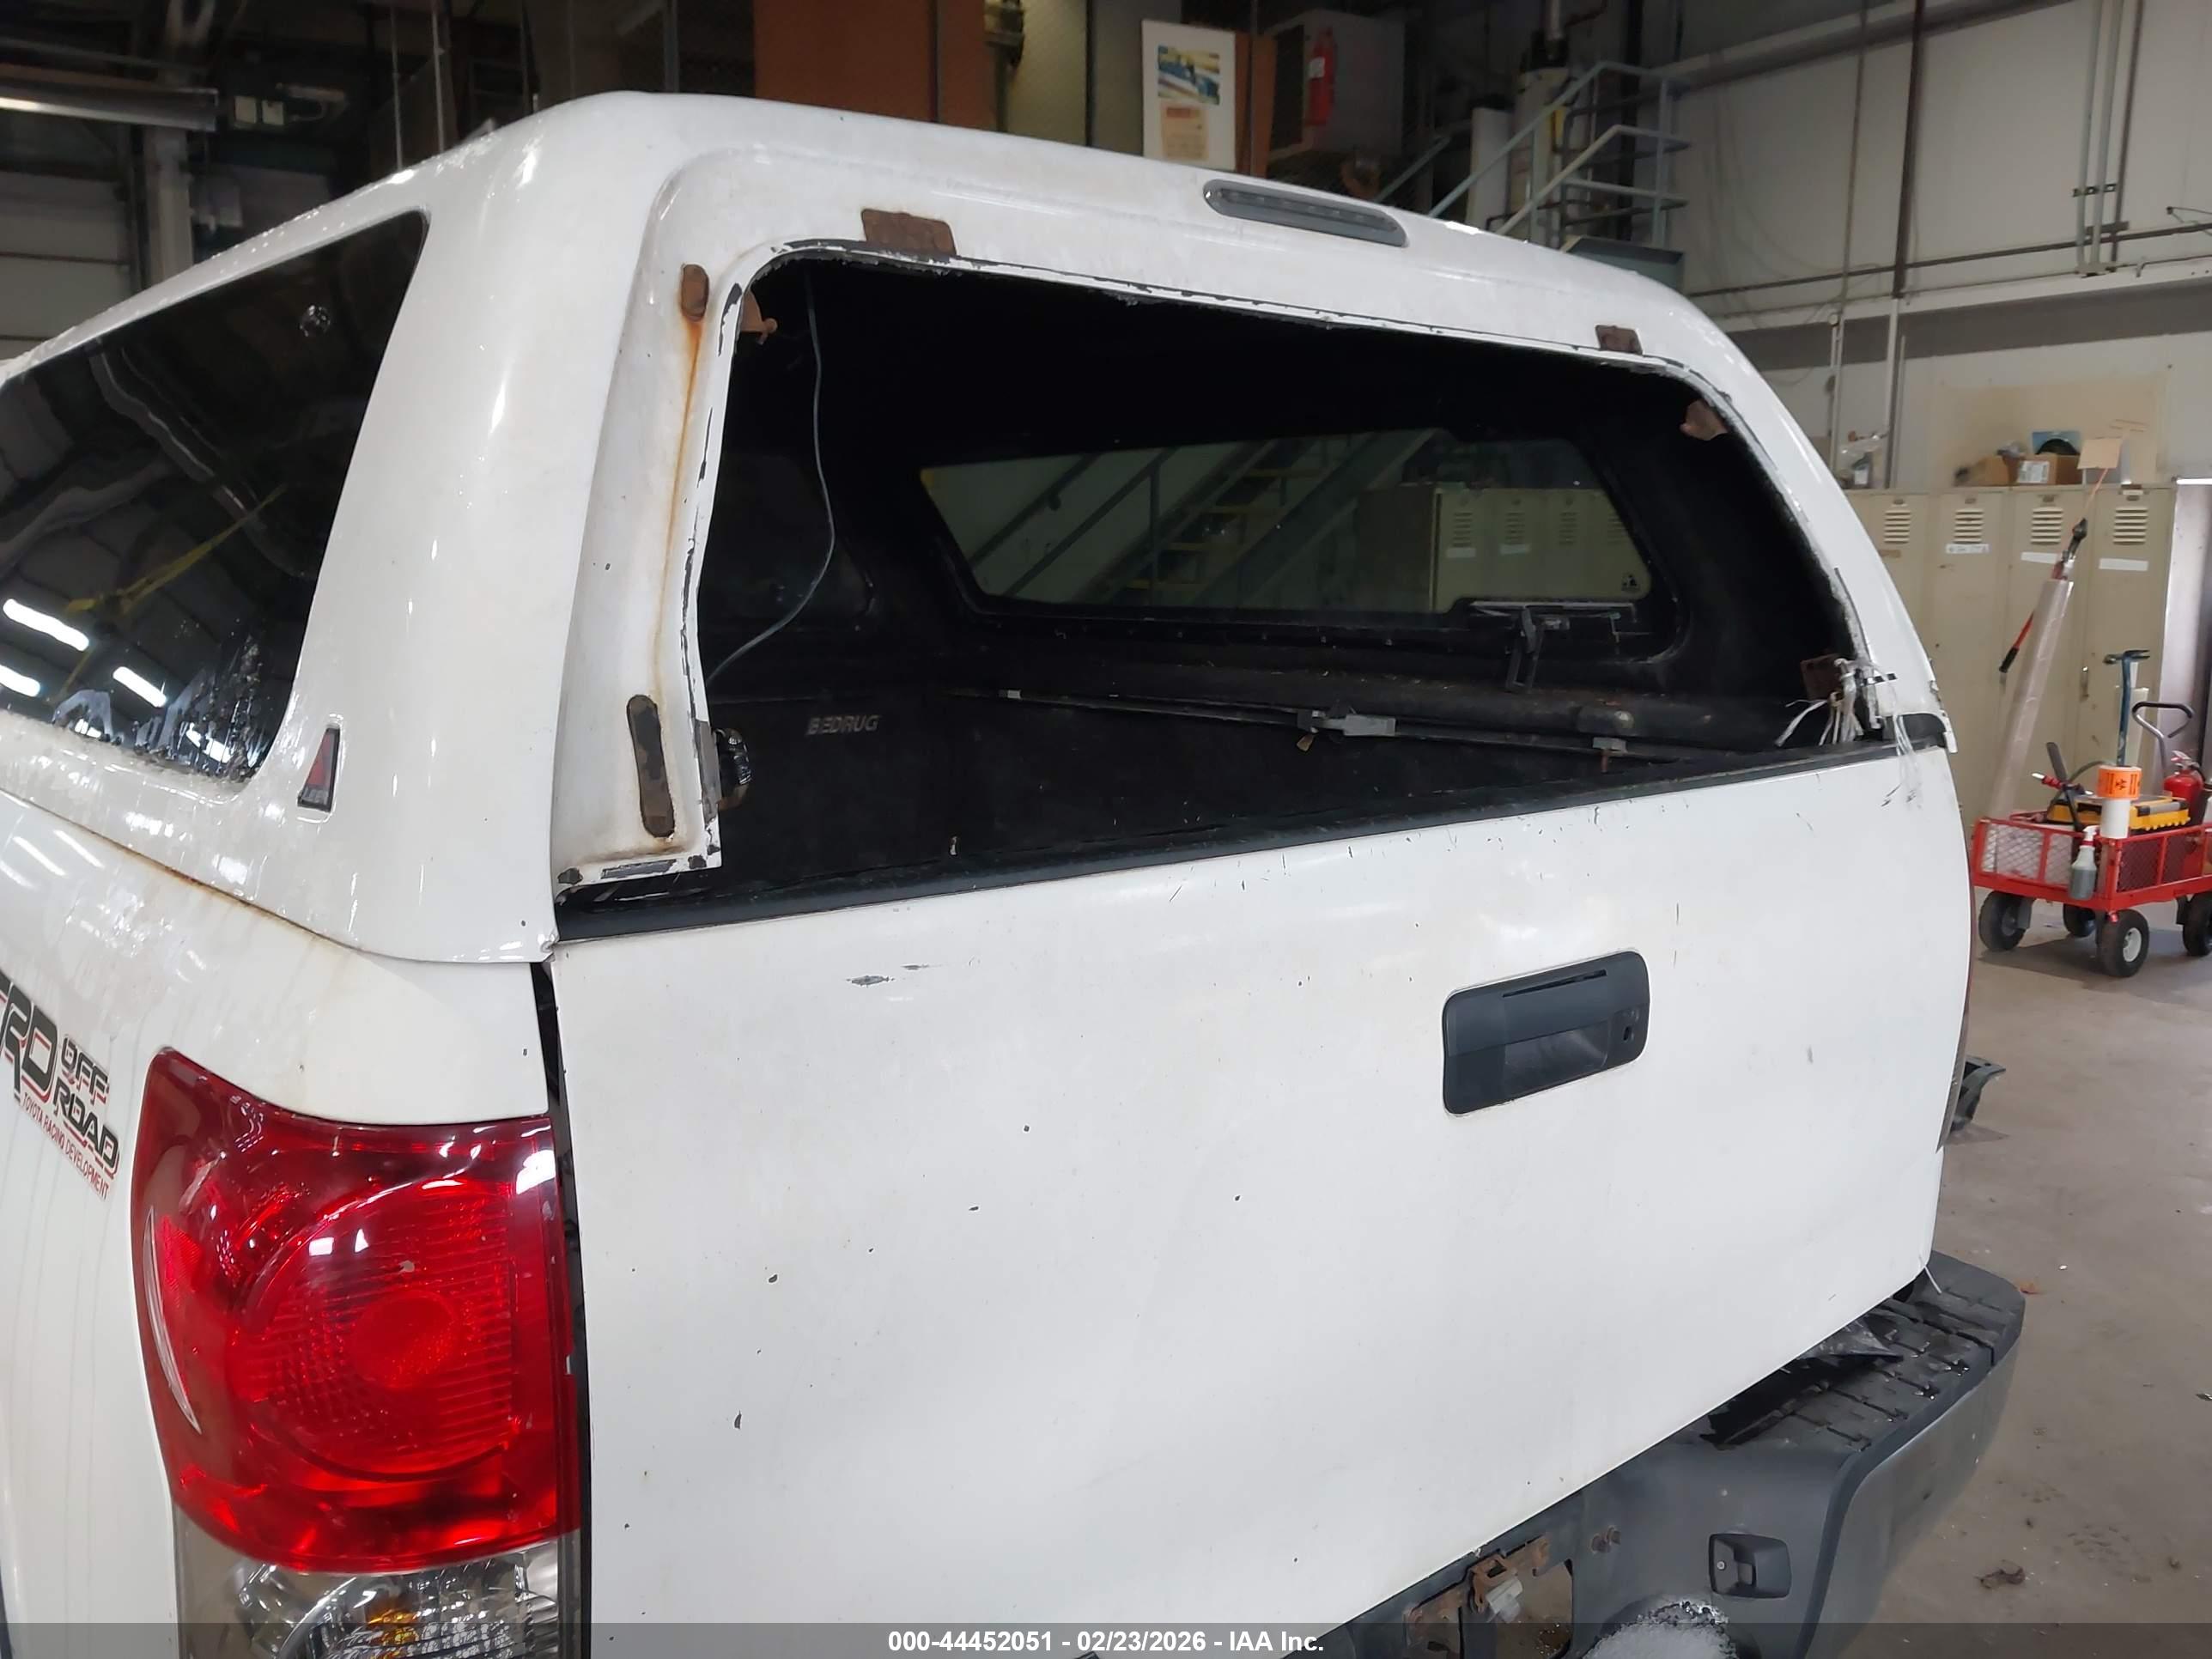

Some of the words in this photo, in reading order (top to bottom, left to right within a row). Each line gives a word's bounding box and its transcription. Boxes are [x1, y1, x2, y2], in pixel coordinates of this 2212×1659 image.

[807, 714, 880, 735] BEDRUG
[61, 1036, 110, 1101] OFF
[23, 1091, 43, 1126] TOYOTA
[43, 1115, 64, 1151] RACING
[65, 1139, 110, 1200] DEVELOPMENT
[53, 1077, 118, 1176] ROAD
